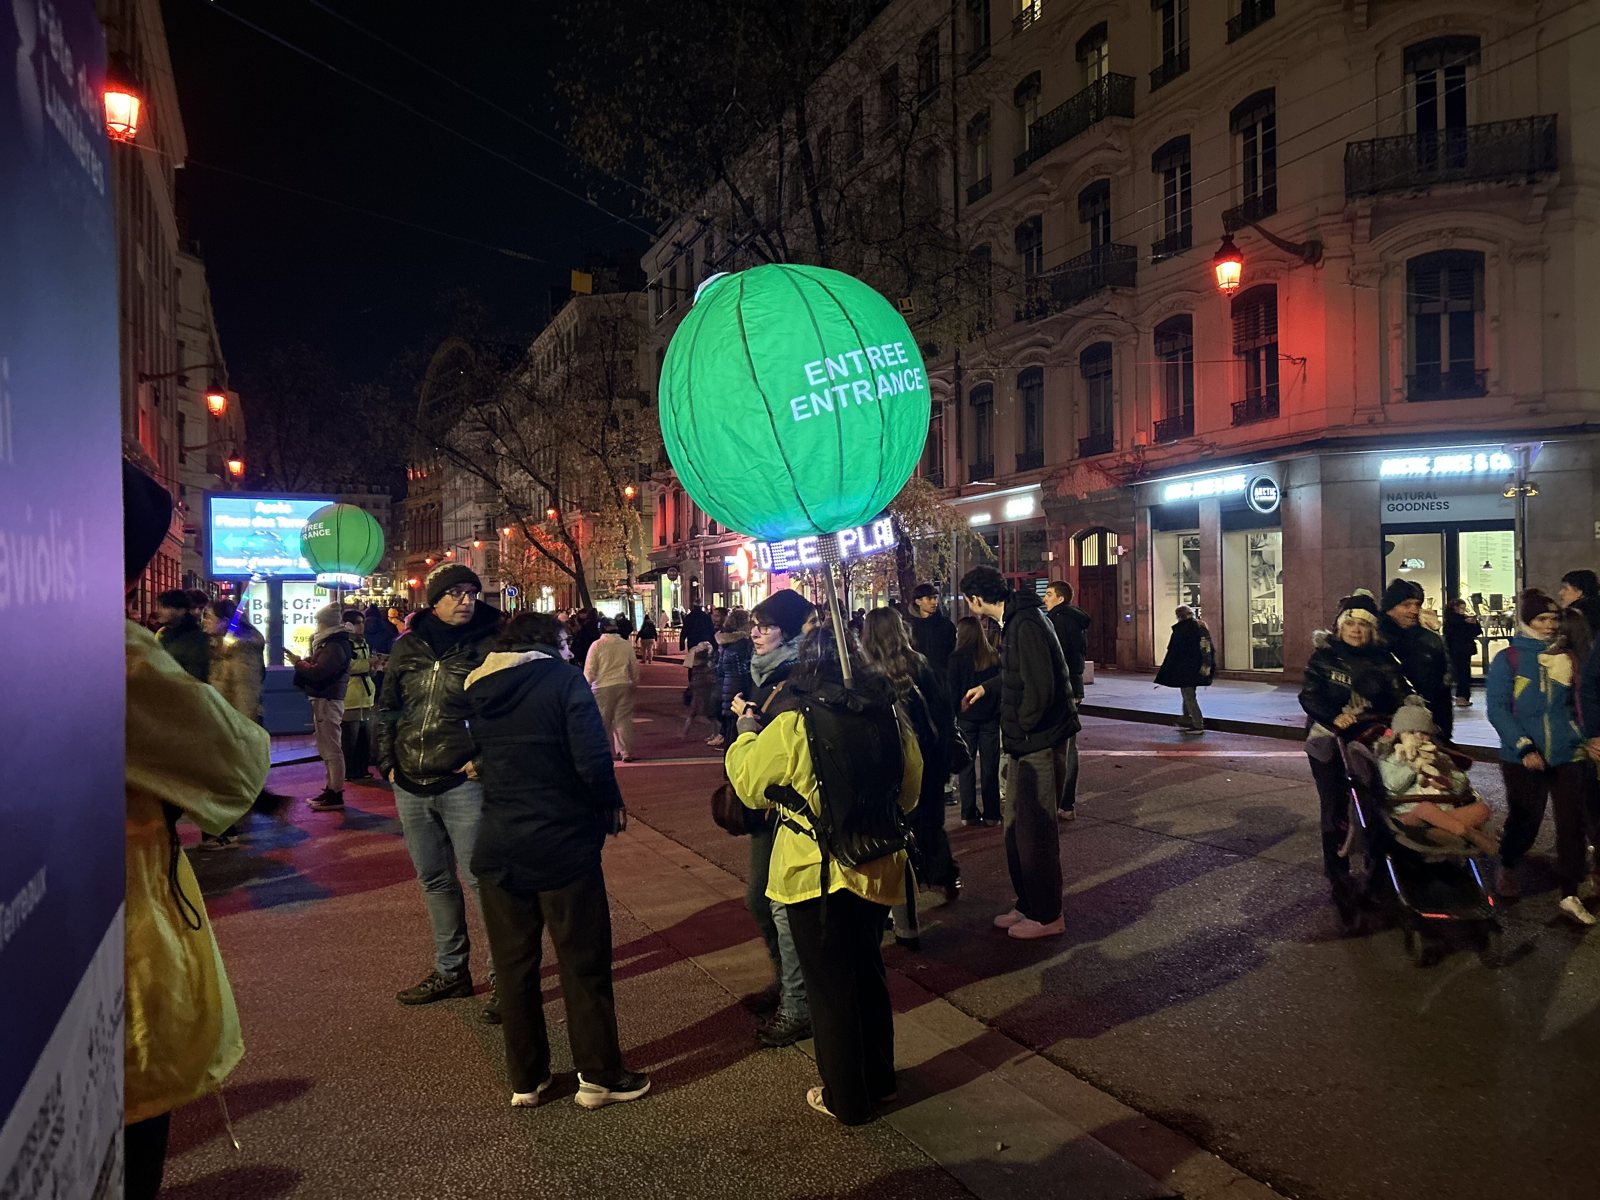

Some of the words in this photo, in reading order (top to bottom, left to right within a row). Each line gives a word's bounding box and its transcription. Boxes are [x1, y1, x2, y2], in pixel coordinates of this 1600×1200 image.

[804, 342, 908, 386] ENTREE
[790, 367, 924, 422] ENTRANCE
[1387, 491, 1438, 501] NATURAL
[1387, 501, 1450, 512] GOODNESS
[253, 599, 288, 611] Bet
[253, 613, 288, 625] Bet
[293, 612, 318, 624] Pri
